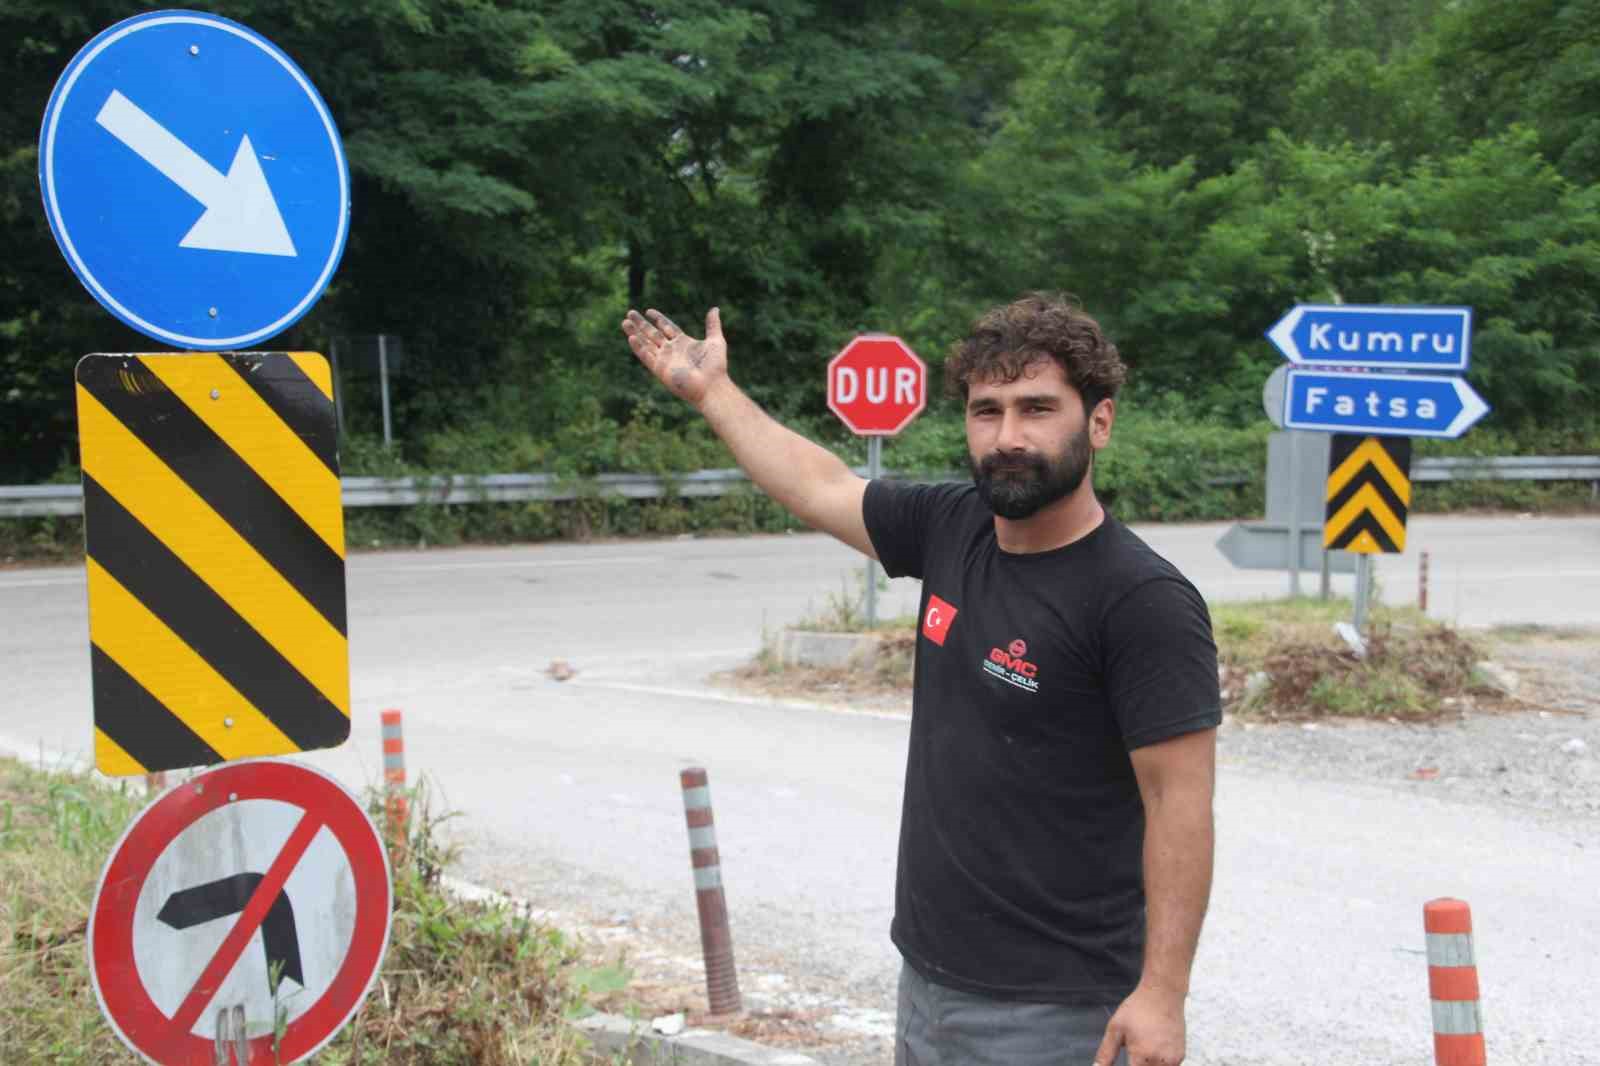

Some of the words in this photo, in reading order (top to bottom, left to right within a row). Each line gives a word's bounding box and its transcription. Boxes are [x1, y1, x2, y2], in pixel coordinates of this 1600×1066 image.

[1309, 322, 1454, 353] Kumru
[836, 367, 916, 404] DUR
[1305, 387, 1437, 419] Fatsa
[990, 647, 1037, 678] GMC
